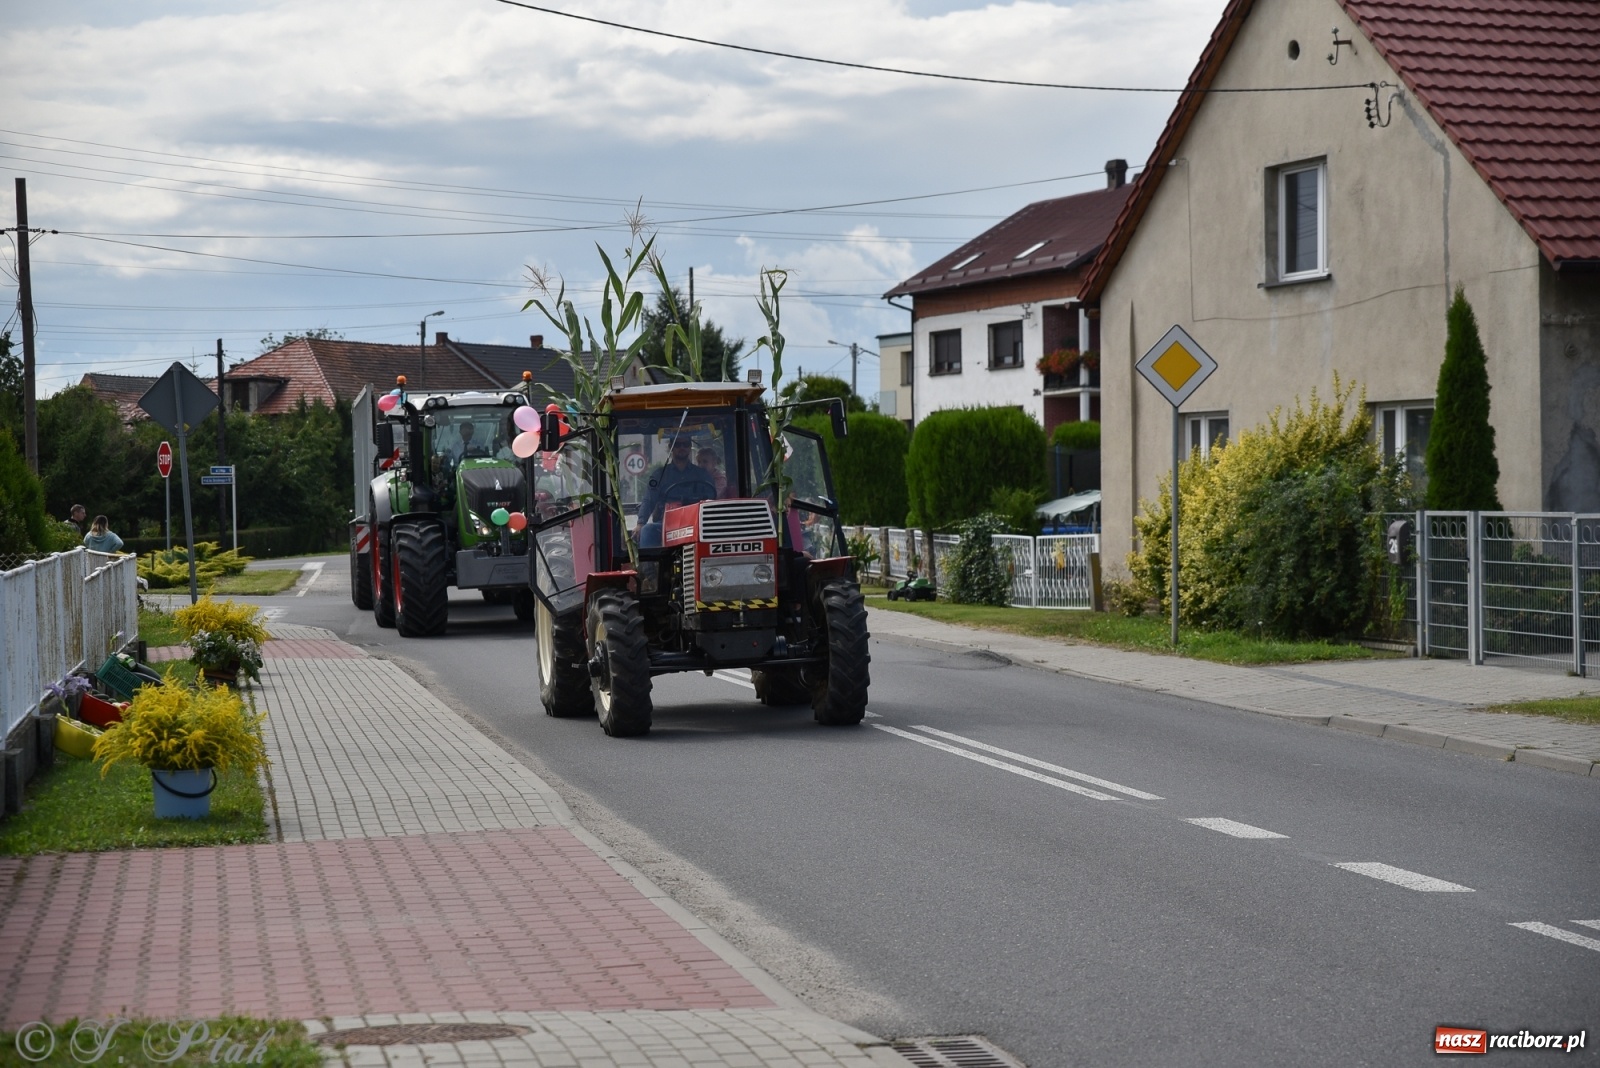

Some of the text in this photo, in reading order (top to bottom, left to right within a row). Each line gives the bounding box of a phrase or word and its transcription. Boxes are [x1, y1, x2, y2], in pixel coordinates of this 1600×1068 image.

[159, 454, 171, 465] STOP
[628, 458, 645, 470] 40
[711, 542, 762, 554] ZETOR
